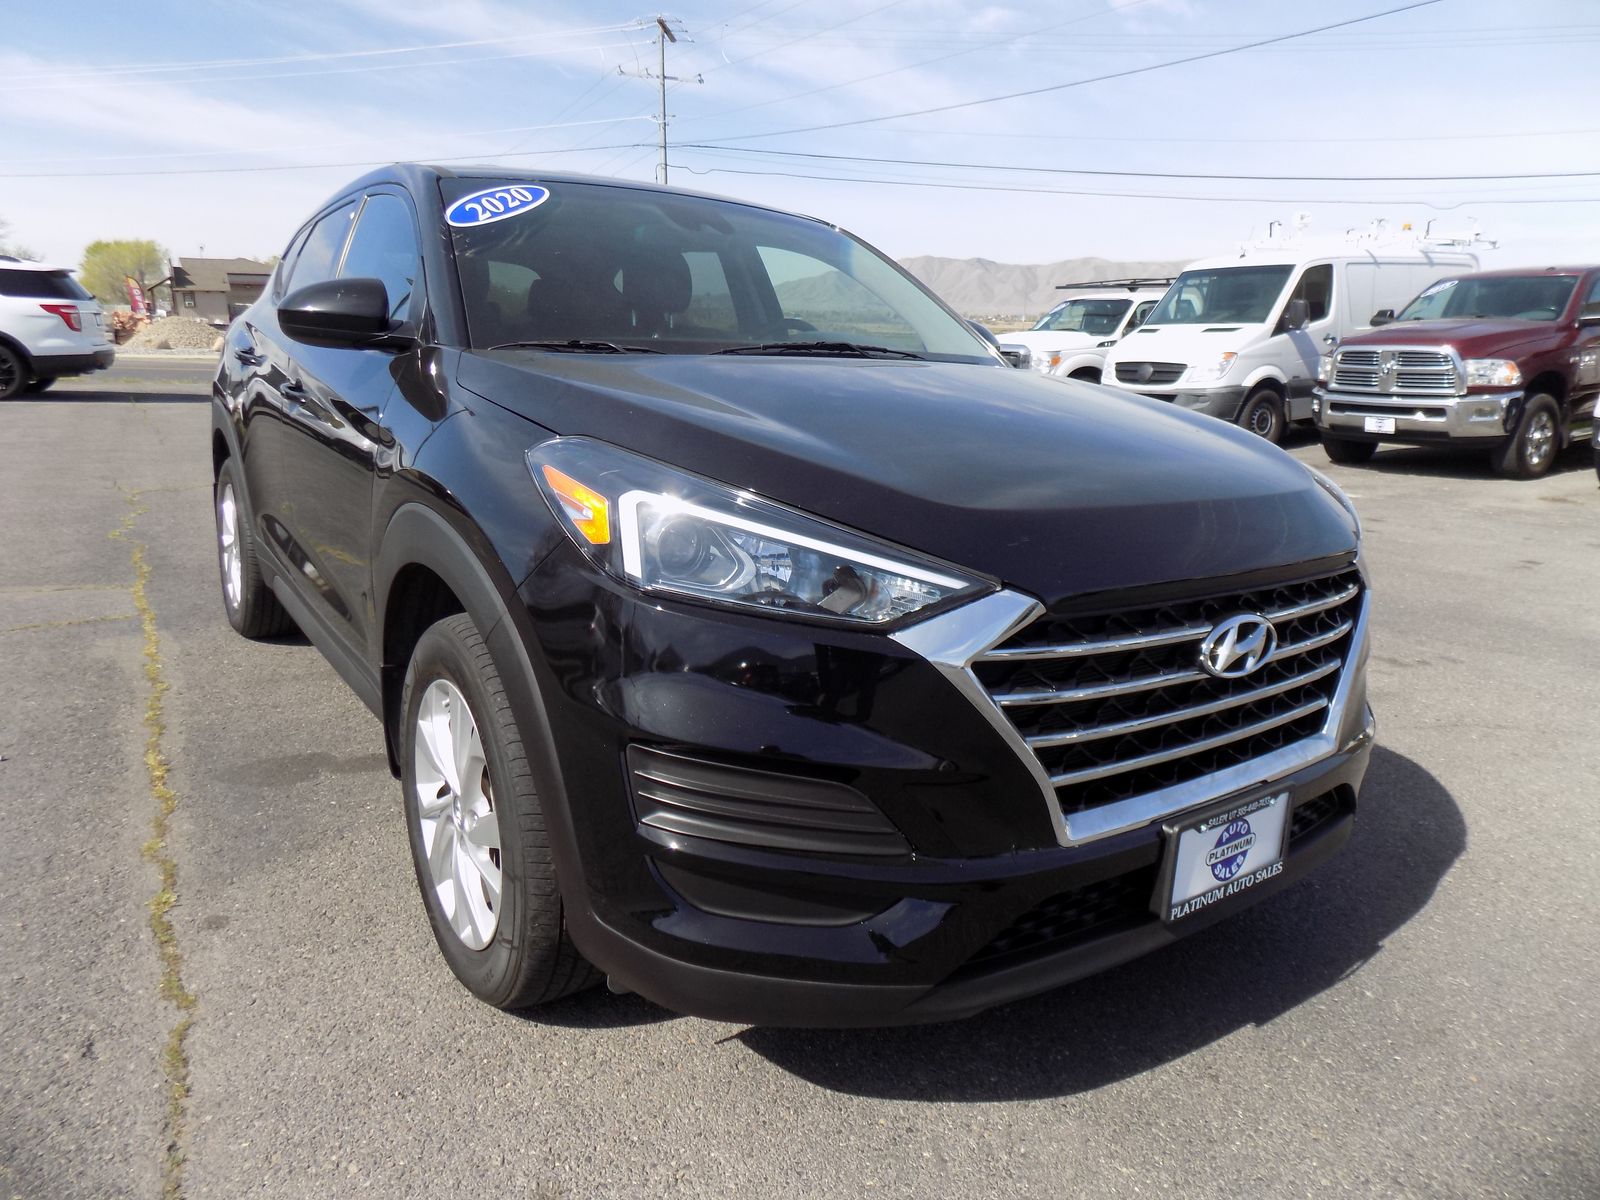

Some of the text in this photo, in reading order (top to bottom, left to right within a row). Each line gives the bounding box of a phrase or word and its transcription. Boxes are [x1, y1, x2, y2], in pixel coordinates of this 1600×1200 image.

[465, 188, 533, 221] 2020
[1222, 821, 1248, 842] AUTO
[1208, 836, 1253, 862] PLATINUM
[1214, 855, 1244, 879] SALES
[1170, 862, 1284, 921] PLATINUM AUTO SALES
